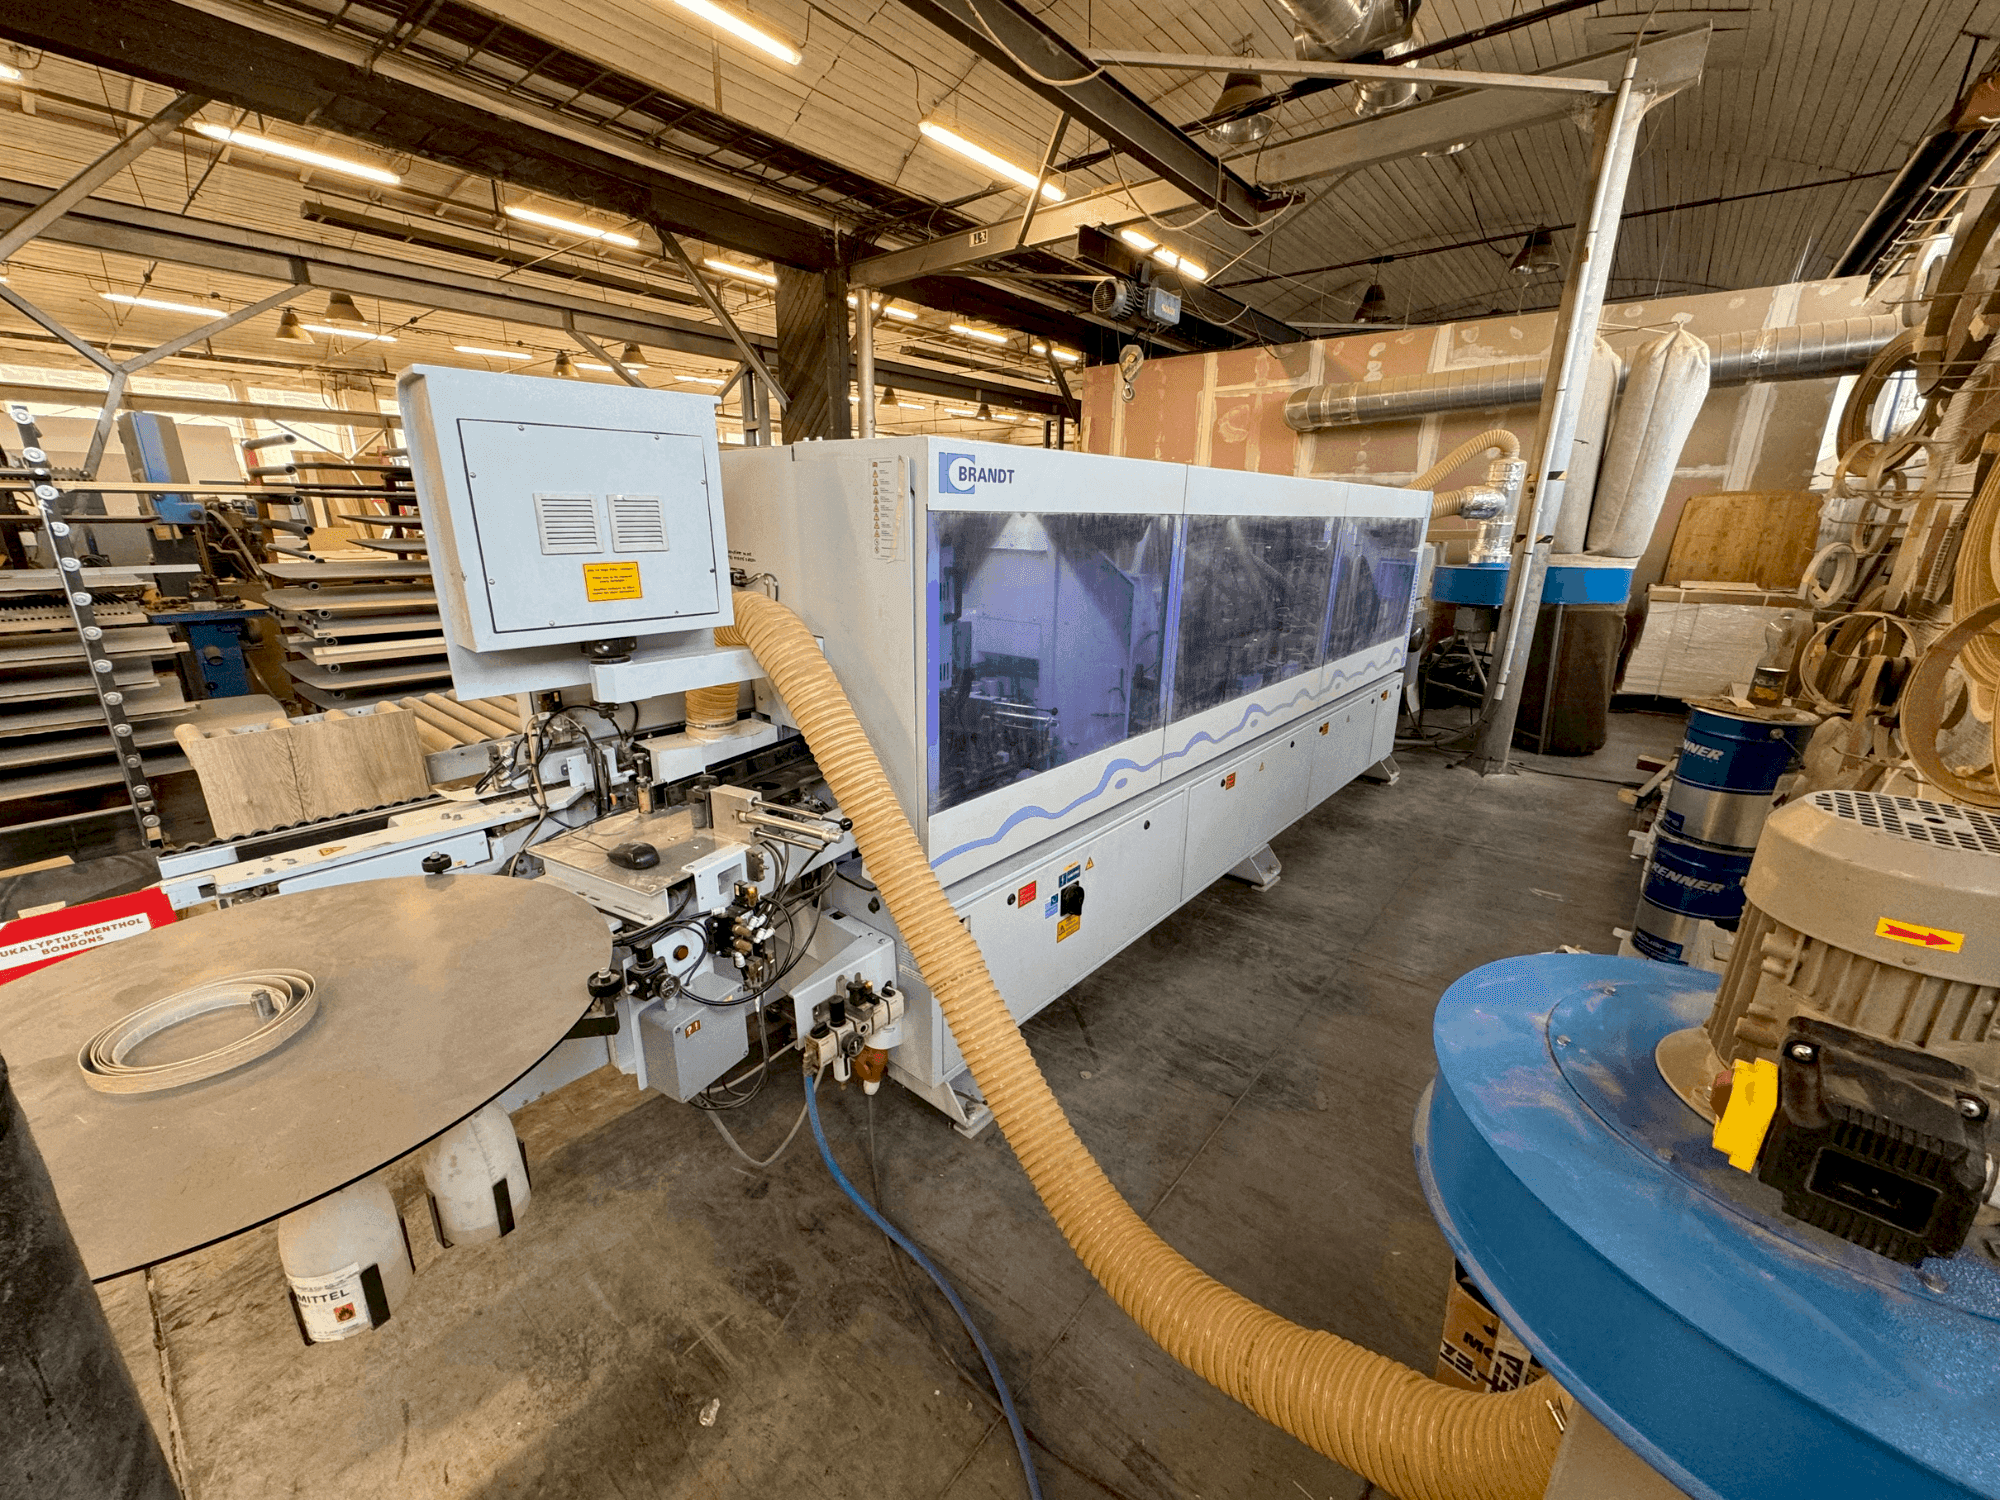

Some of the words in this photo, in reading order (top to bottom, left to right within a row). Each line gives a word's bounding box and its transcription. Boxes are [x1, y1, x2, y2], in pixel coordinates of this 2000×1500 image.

[958, 465, 1015, 484] BRANDT
[0, 917, 144, 958] UKALYPTUS-MENTHOL
[41, 934, 105, 956] BONBONS
